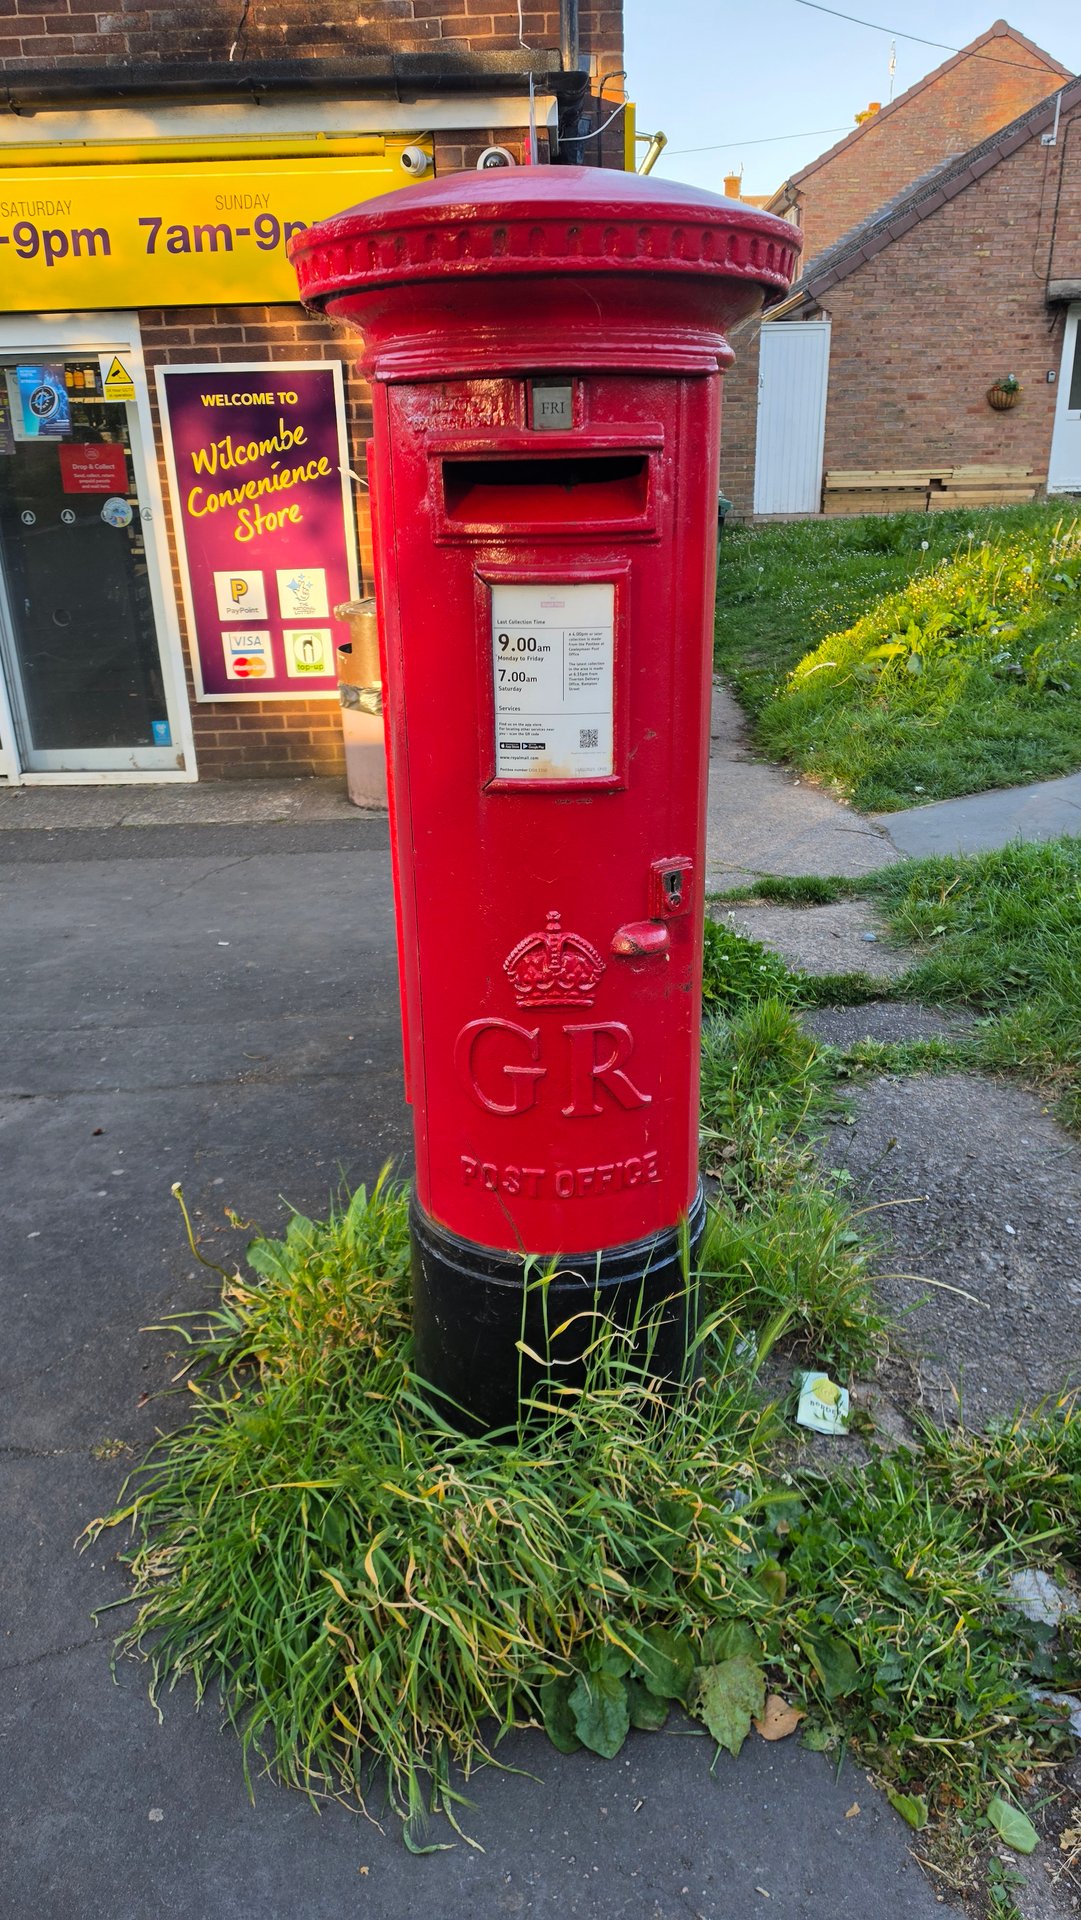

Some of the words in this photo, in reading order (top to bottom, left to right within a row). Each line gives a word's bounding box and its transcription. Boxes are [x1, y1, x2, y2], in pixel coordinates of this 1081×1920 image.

[1, 199, 72, 218] SATURDAY
[215, 193, 270, 211] SUNDAY
[201, 392, 274, 407] WELCOME
[277, 391, 298, 405] TO
[541, 401, 565, 415] FRI
[191, 417, 307, 475] Wilcombe
[187, 456, 332, 517] Convenience
[234, 503, 303, 542] Store
[226, 607, 259, 615] PayPoint
[234, 635, 262, 647] VISA
[498, 633, 551, 652] 9.00am
[297, 663, 325, 672] top-up
[498, 669, 537, 683] 7.00am
[460, 1154, 547, 1198] POST
[554, 1150, 664, 1199] OFFICE
